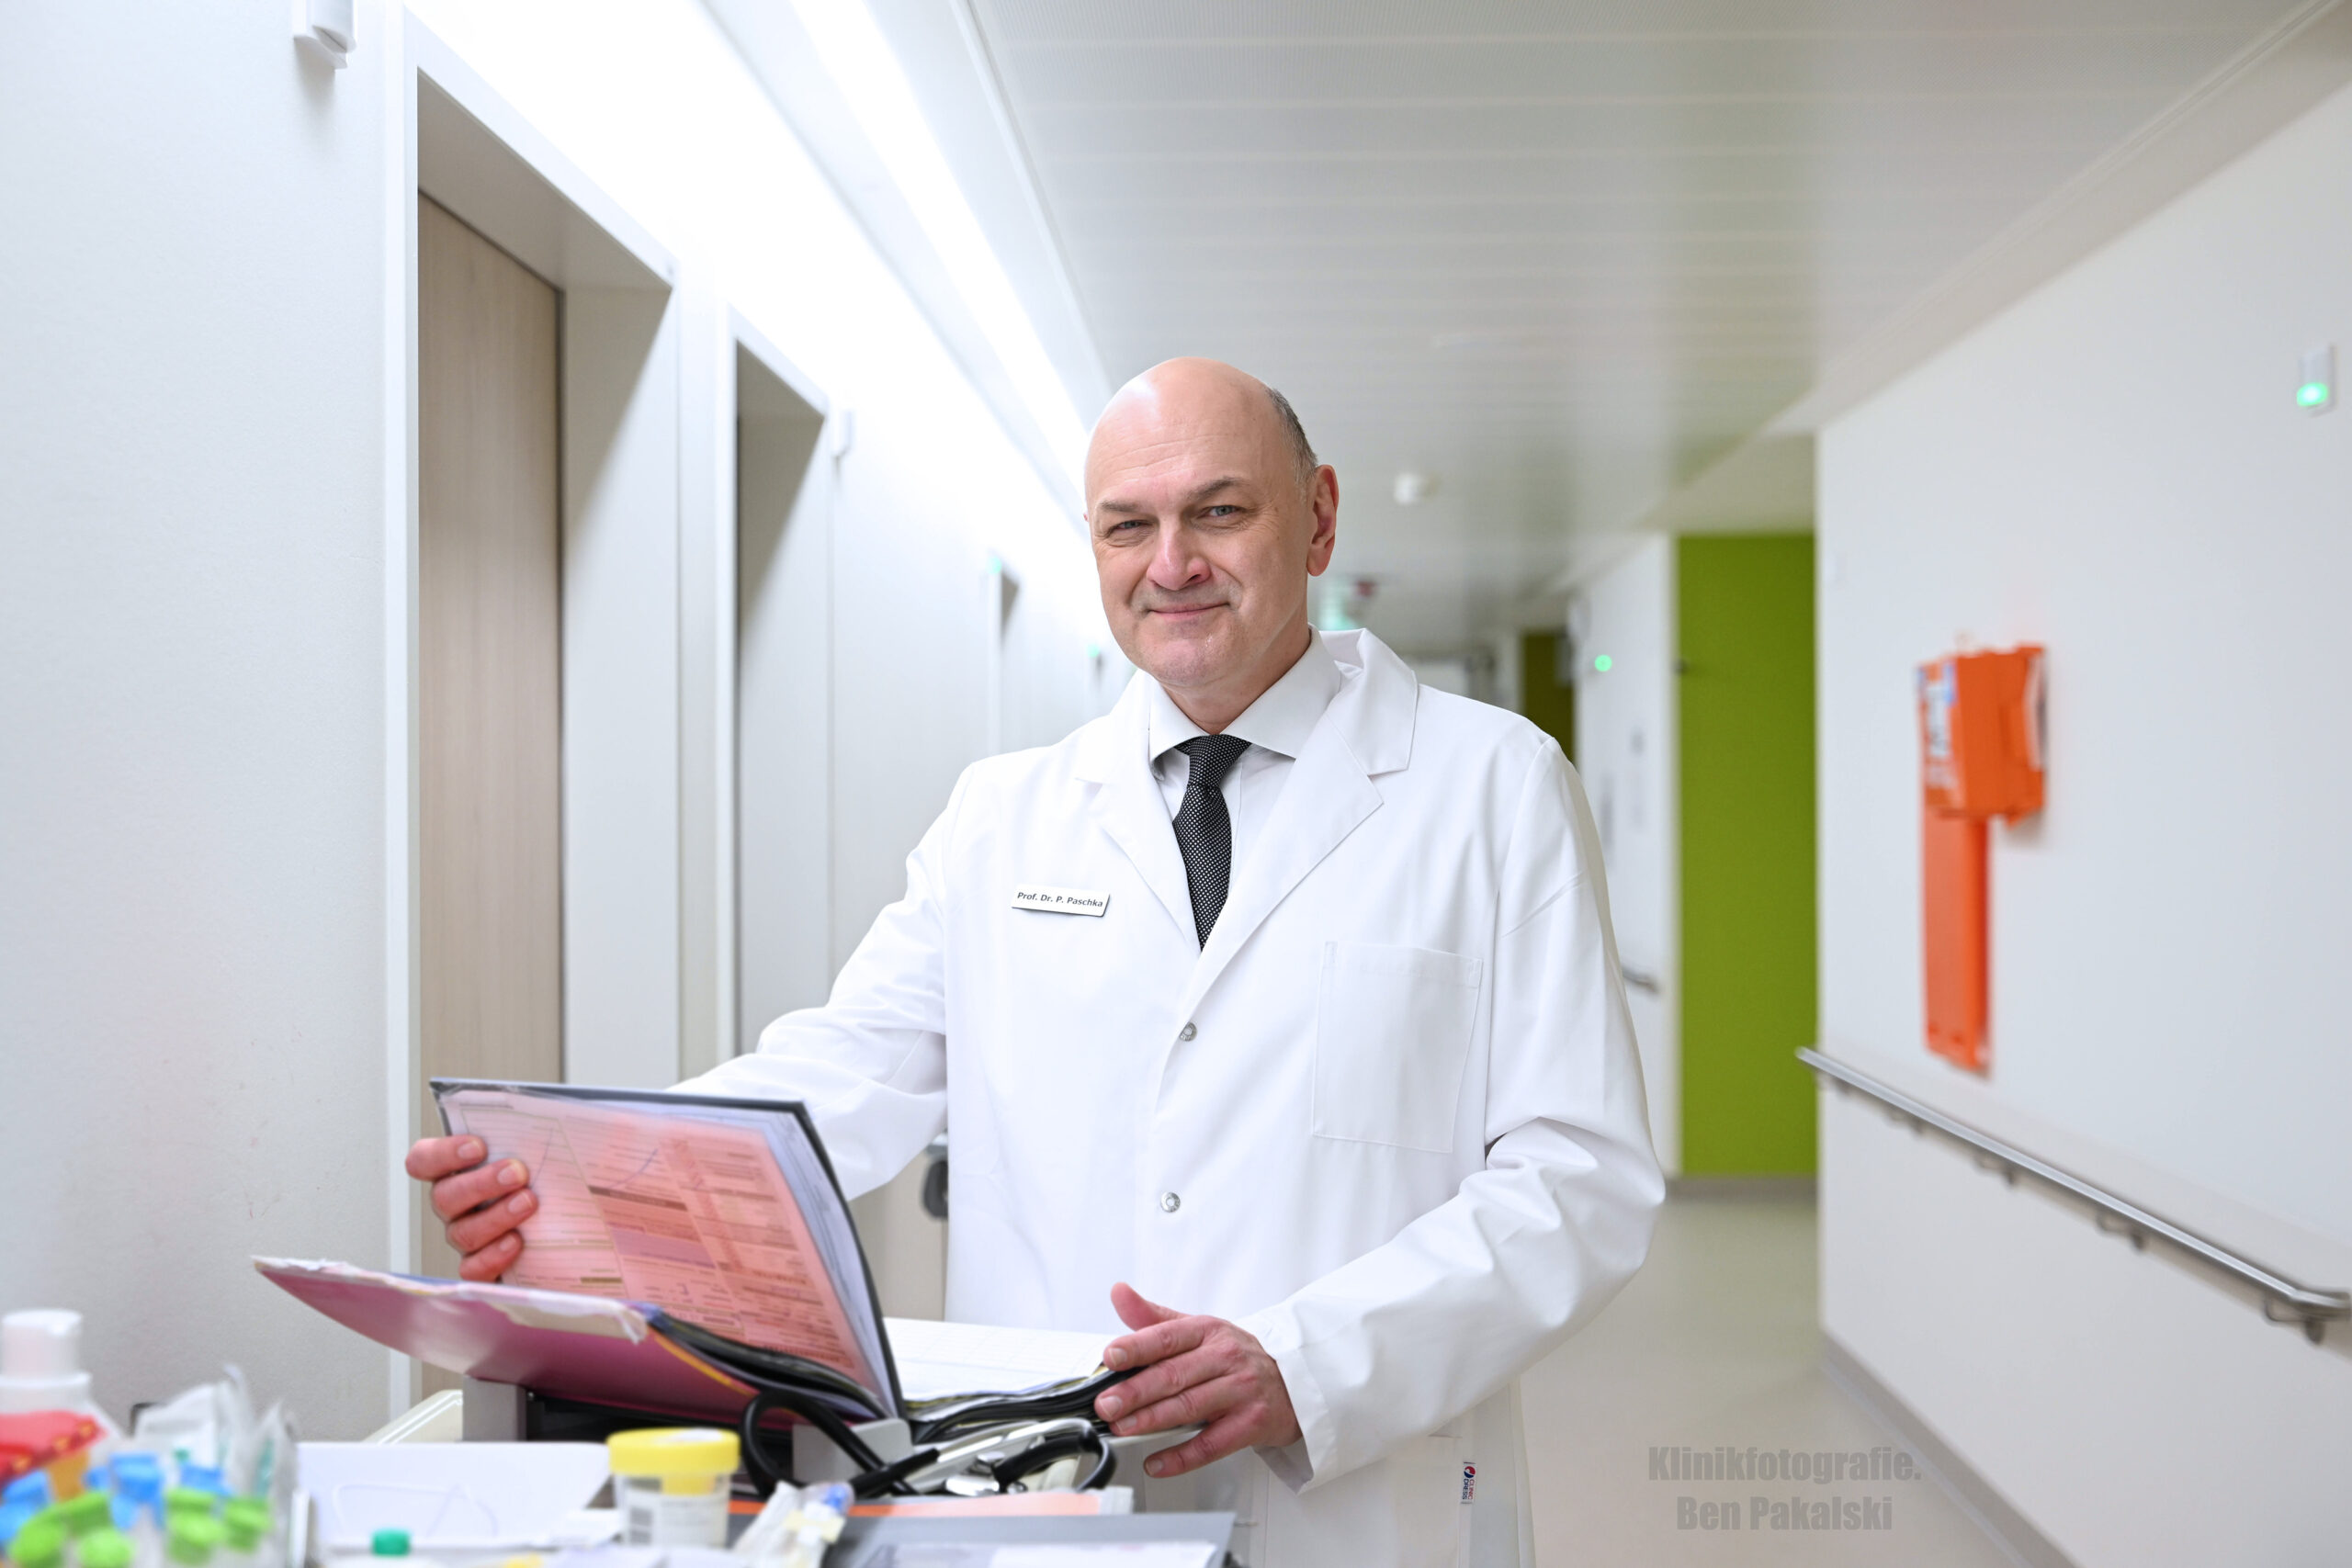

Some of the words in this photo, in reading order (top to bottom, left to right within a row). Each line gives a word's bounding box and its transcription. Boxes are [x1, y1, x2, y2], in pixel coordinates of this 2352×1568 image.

[1017, 892, 1037, 901] Prof.
[1040, 894, 1053, 903] Dr.
[1056, 896, 1064, 904] P.
[1067, 897, 1103, 907] Paschka
